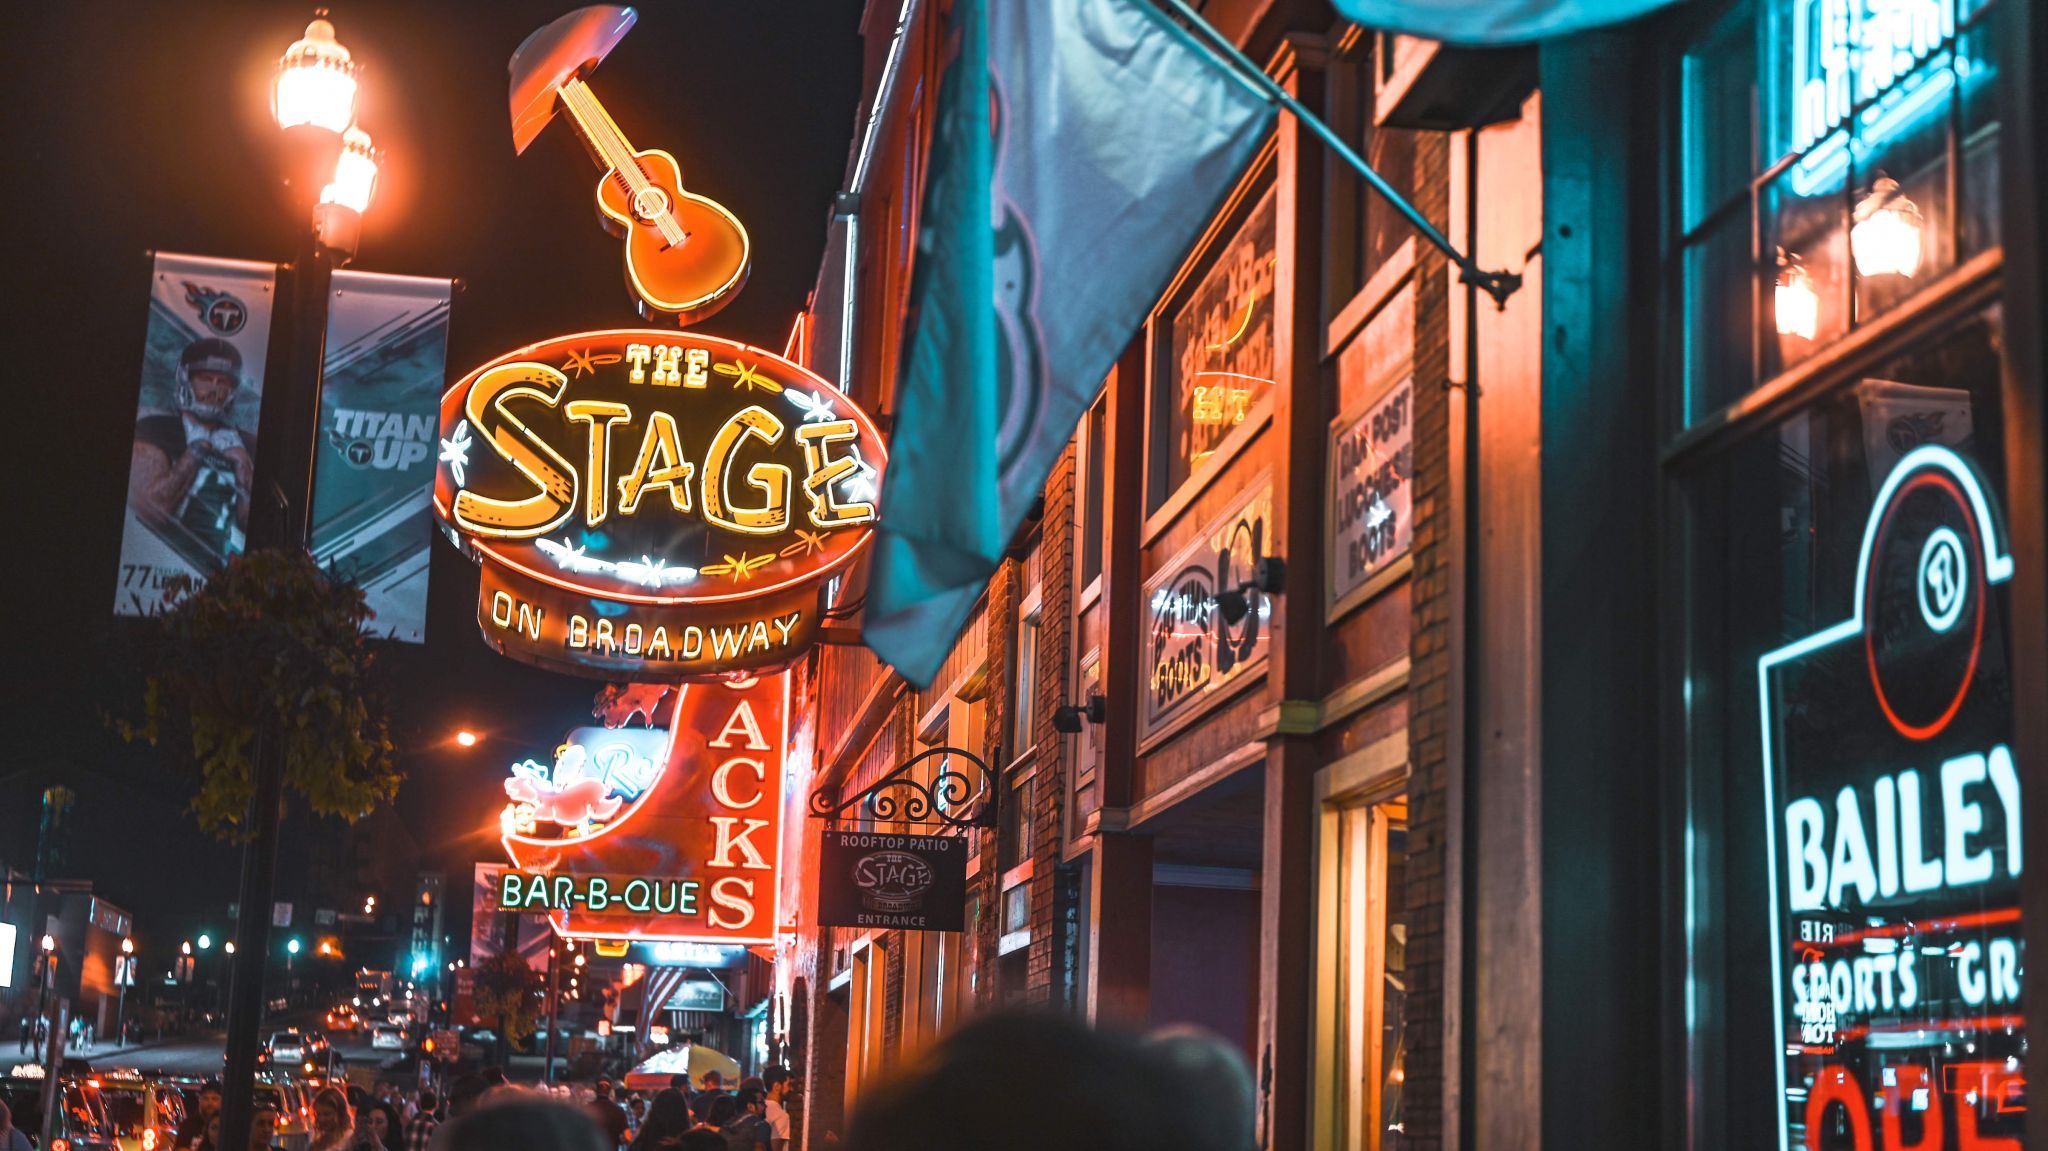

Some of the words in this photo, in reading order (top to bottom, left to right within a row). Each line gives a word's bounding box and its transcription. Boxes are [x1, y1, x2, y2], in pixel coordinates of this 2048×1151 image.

[625, 344, 710, 388] THE
[333, 408, 436, 442] TITAN
[1372, 386, 1410, 444] POST
[371, 440, 428, 471] UP
[452, 361, 877, 539] STAGE
[122, 564, 153, 589] 77
[491, 589, 543, 640] ON
[568, 611, 800, 660] BROADWAY
[1157, 635, 1203, 709] BOOTS
[706, 676, 774, 931] ACKS
[840, 835, 905, 850] ROOFTOP
[909, 837, 949, 851] PATIO
[502, 873, 700, 915] BAR-B-QUE
[857, 856, 931, 889] STAGE
[857, 914, 927, 927] ENTRANCE
[1792, 949, 1918, 1018] SPORTS
